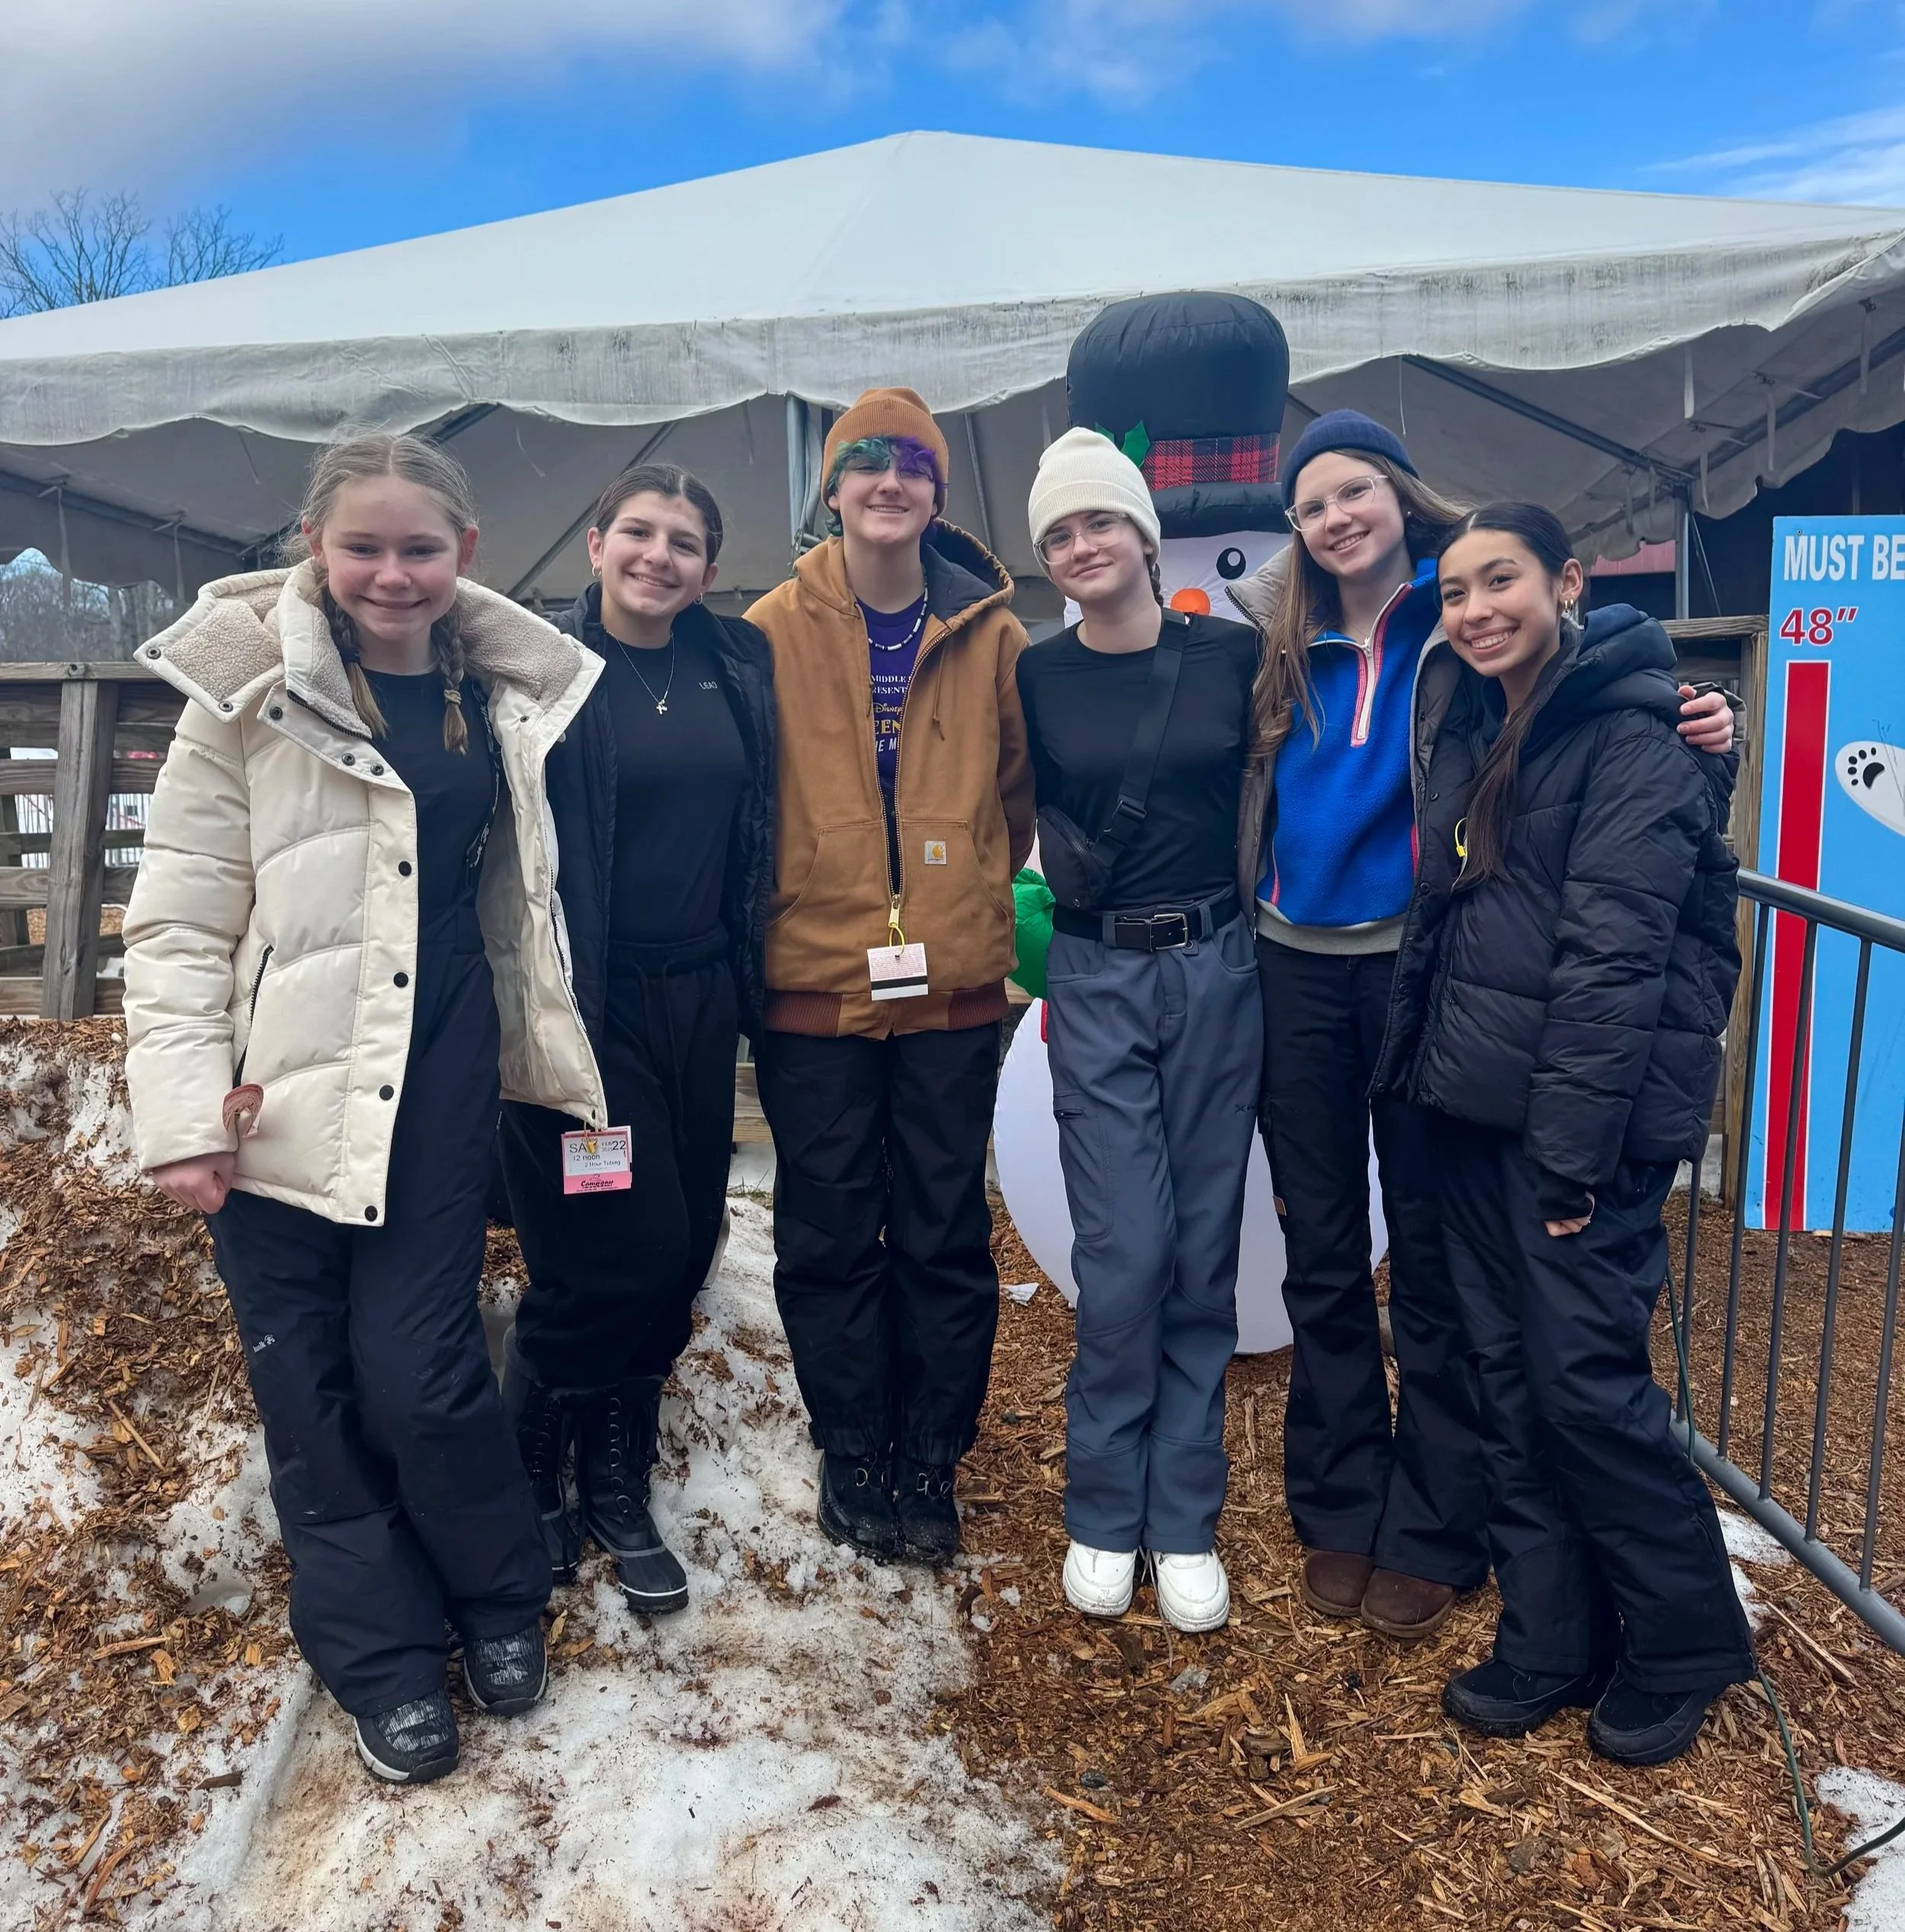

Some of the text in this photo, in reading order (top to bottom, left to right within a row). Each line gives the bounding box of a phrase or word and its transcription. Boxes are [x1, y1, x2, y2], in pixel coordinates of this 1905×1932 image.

[1784, 534, 1905, 581] MUST BE
[569, 1142, 591, 1153] SA
[612, 1140, 626, 1150] 22
